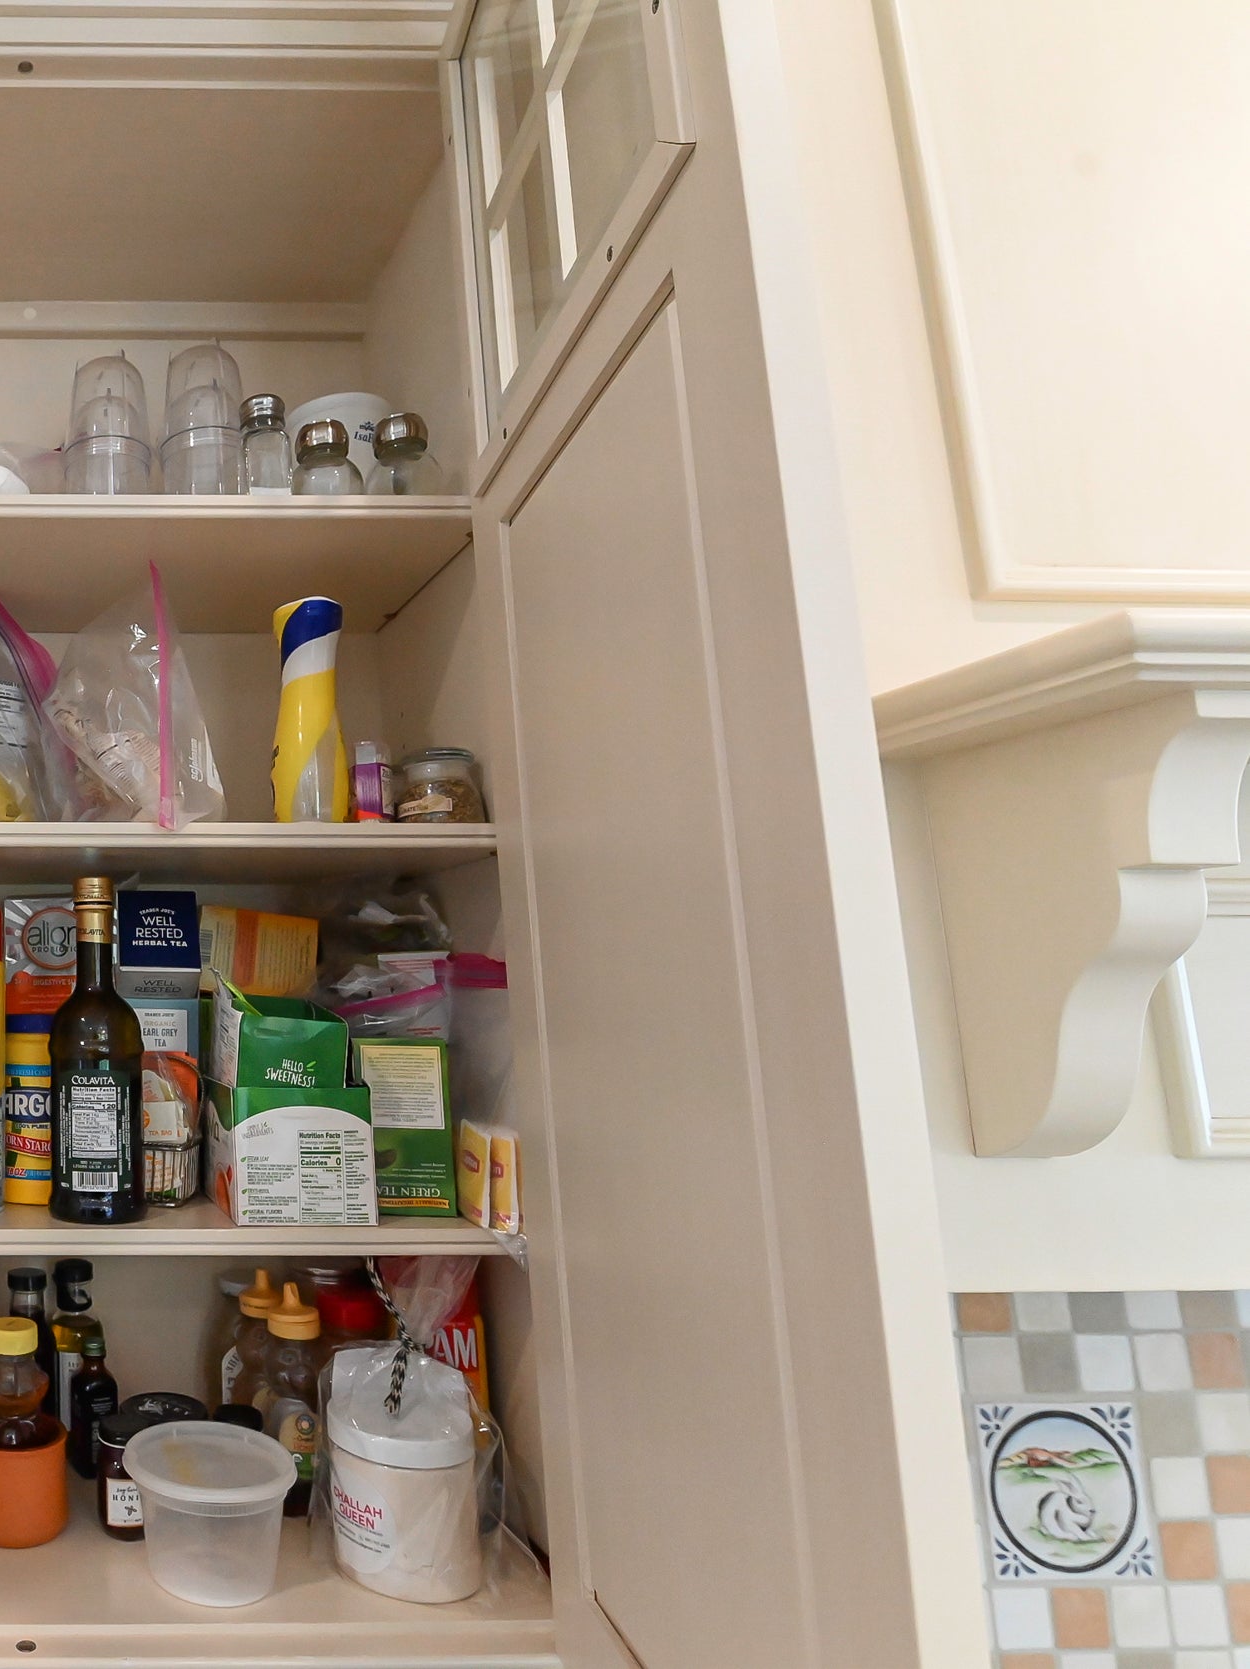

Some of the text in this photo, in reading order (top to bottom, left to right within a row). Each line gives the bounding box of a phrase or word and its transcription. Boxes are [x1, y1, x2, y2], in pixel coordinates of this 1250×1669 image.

[139, 907, 175, 915] TRADER JOE'S
[142, 916, 176, 927] WELL
[28, 920, 77, 957] align
[135, 927, 183, 939] RESTED
[143, 1028, 178, 1037] EARL GREY
[154, 1039, 166, 1047] TEA
[282, 1059, 304, 1072] HELLO
[71, 1075, 115, 1085] COLAVITA
[265, 1067, 316, 1089] SWEETNESS!
[6, 1134, 25, 1150] ORN
[336, 1157, 341, 1166] 0
[376, 1186, 441, 1197] GREEN TEA
[434, 1327, 477, 1369] AM
[334, 1485, 382, 1520] CHALLAH
[340, 1503, 374, 1530] QUEEN
